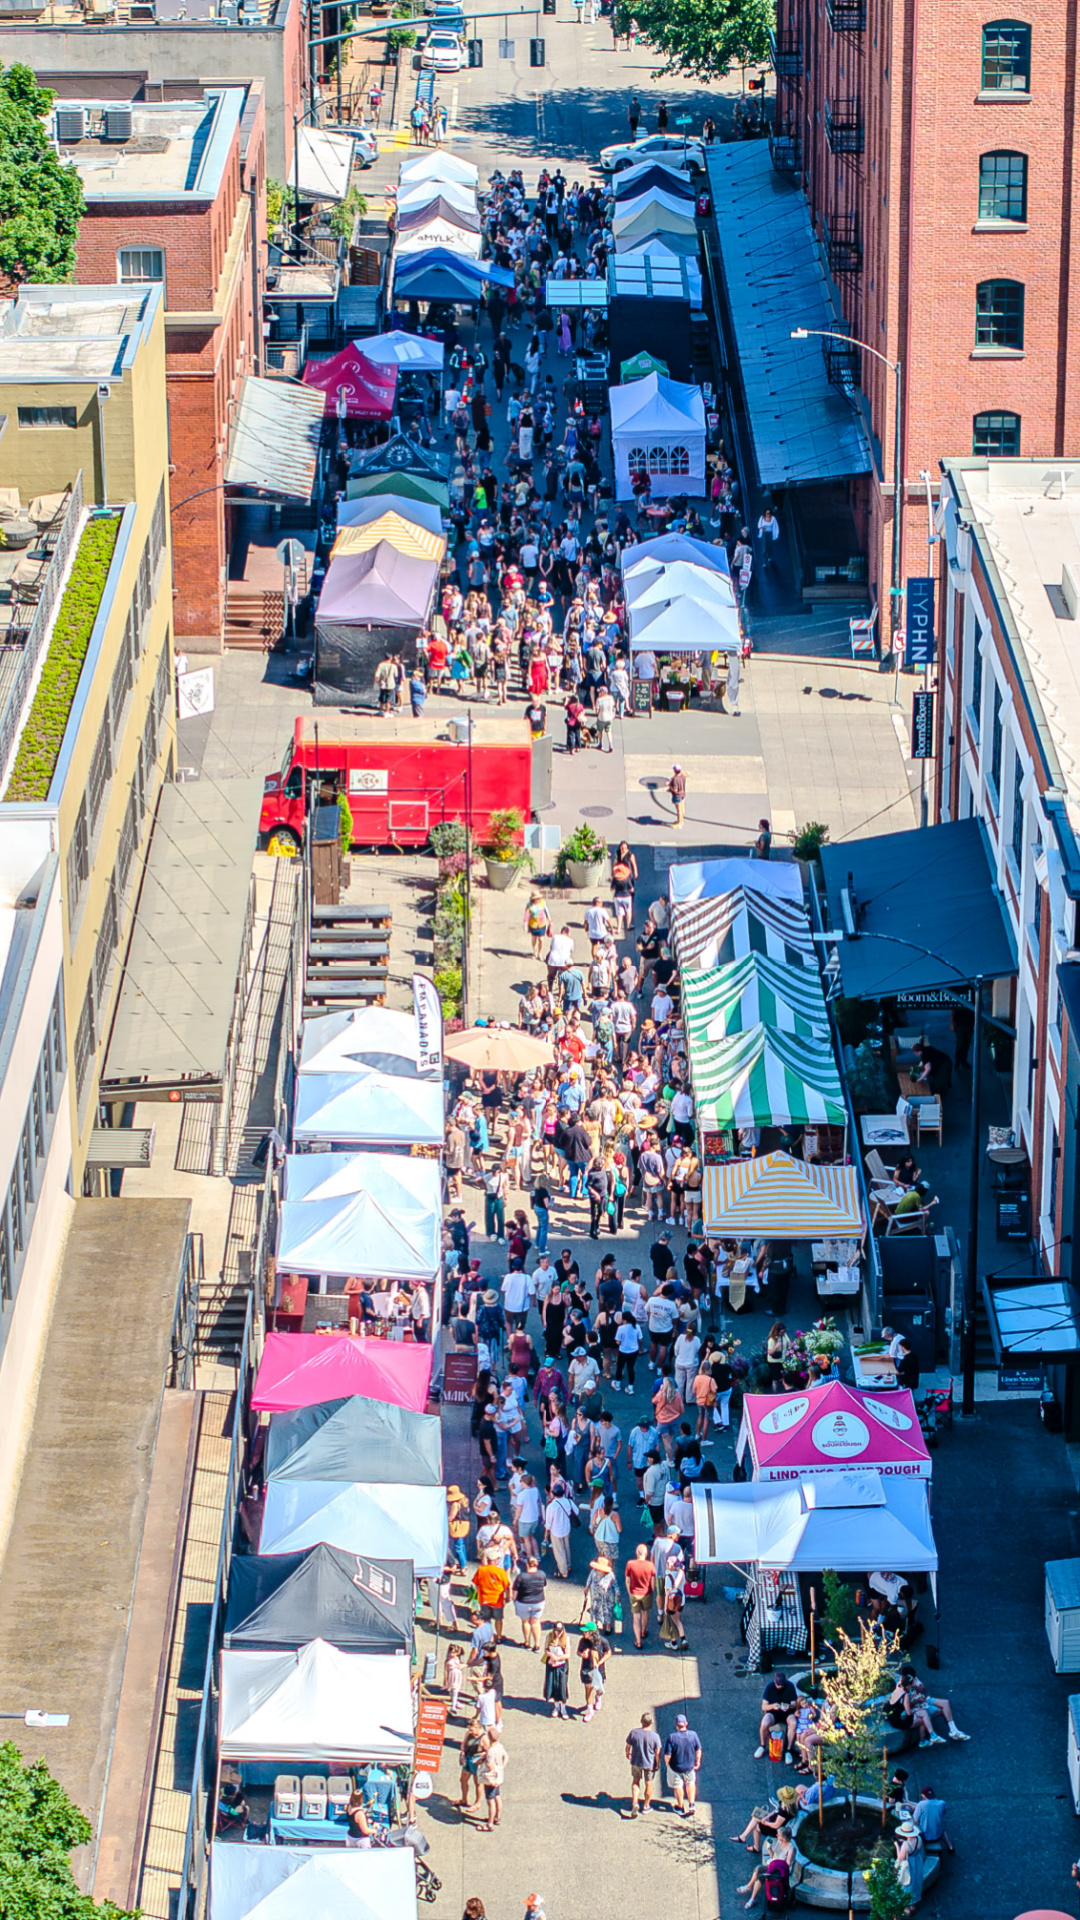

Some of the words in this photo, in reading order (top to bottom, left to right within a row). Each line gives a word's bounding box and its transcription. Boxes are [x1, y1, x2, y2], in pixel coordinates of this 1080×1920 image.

[912, 582, 929, 661] HYPHN
[915, 694, 927, 758] Room&Board
[418, 983, 429, 1067] EMPANADAS
[415, 1758, 437, 1767] DUCK
[421, 1727, 442, 1735] PORK
